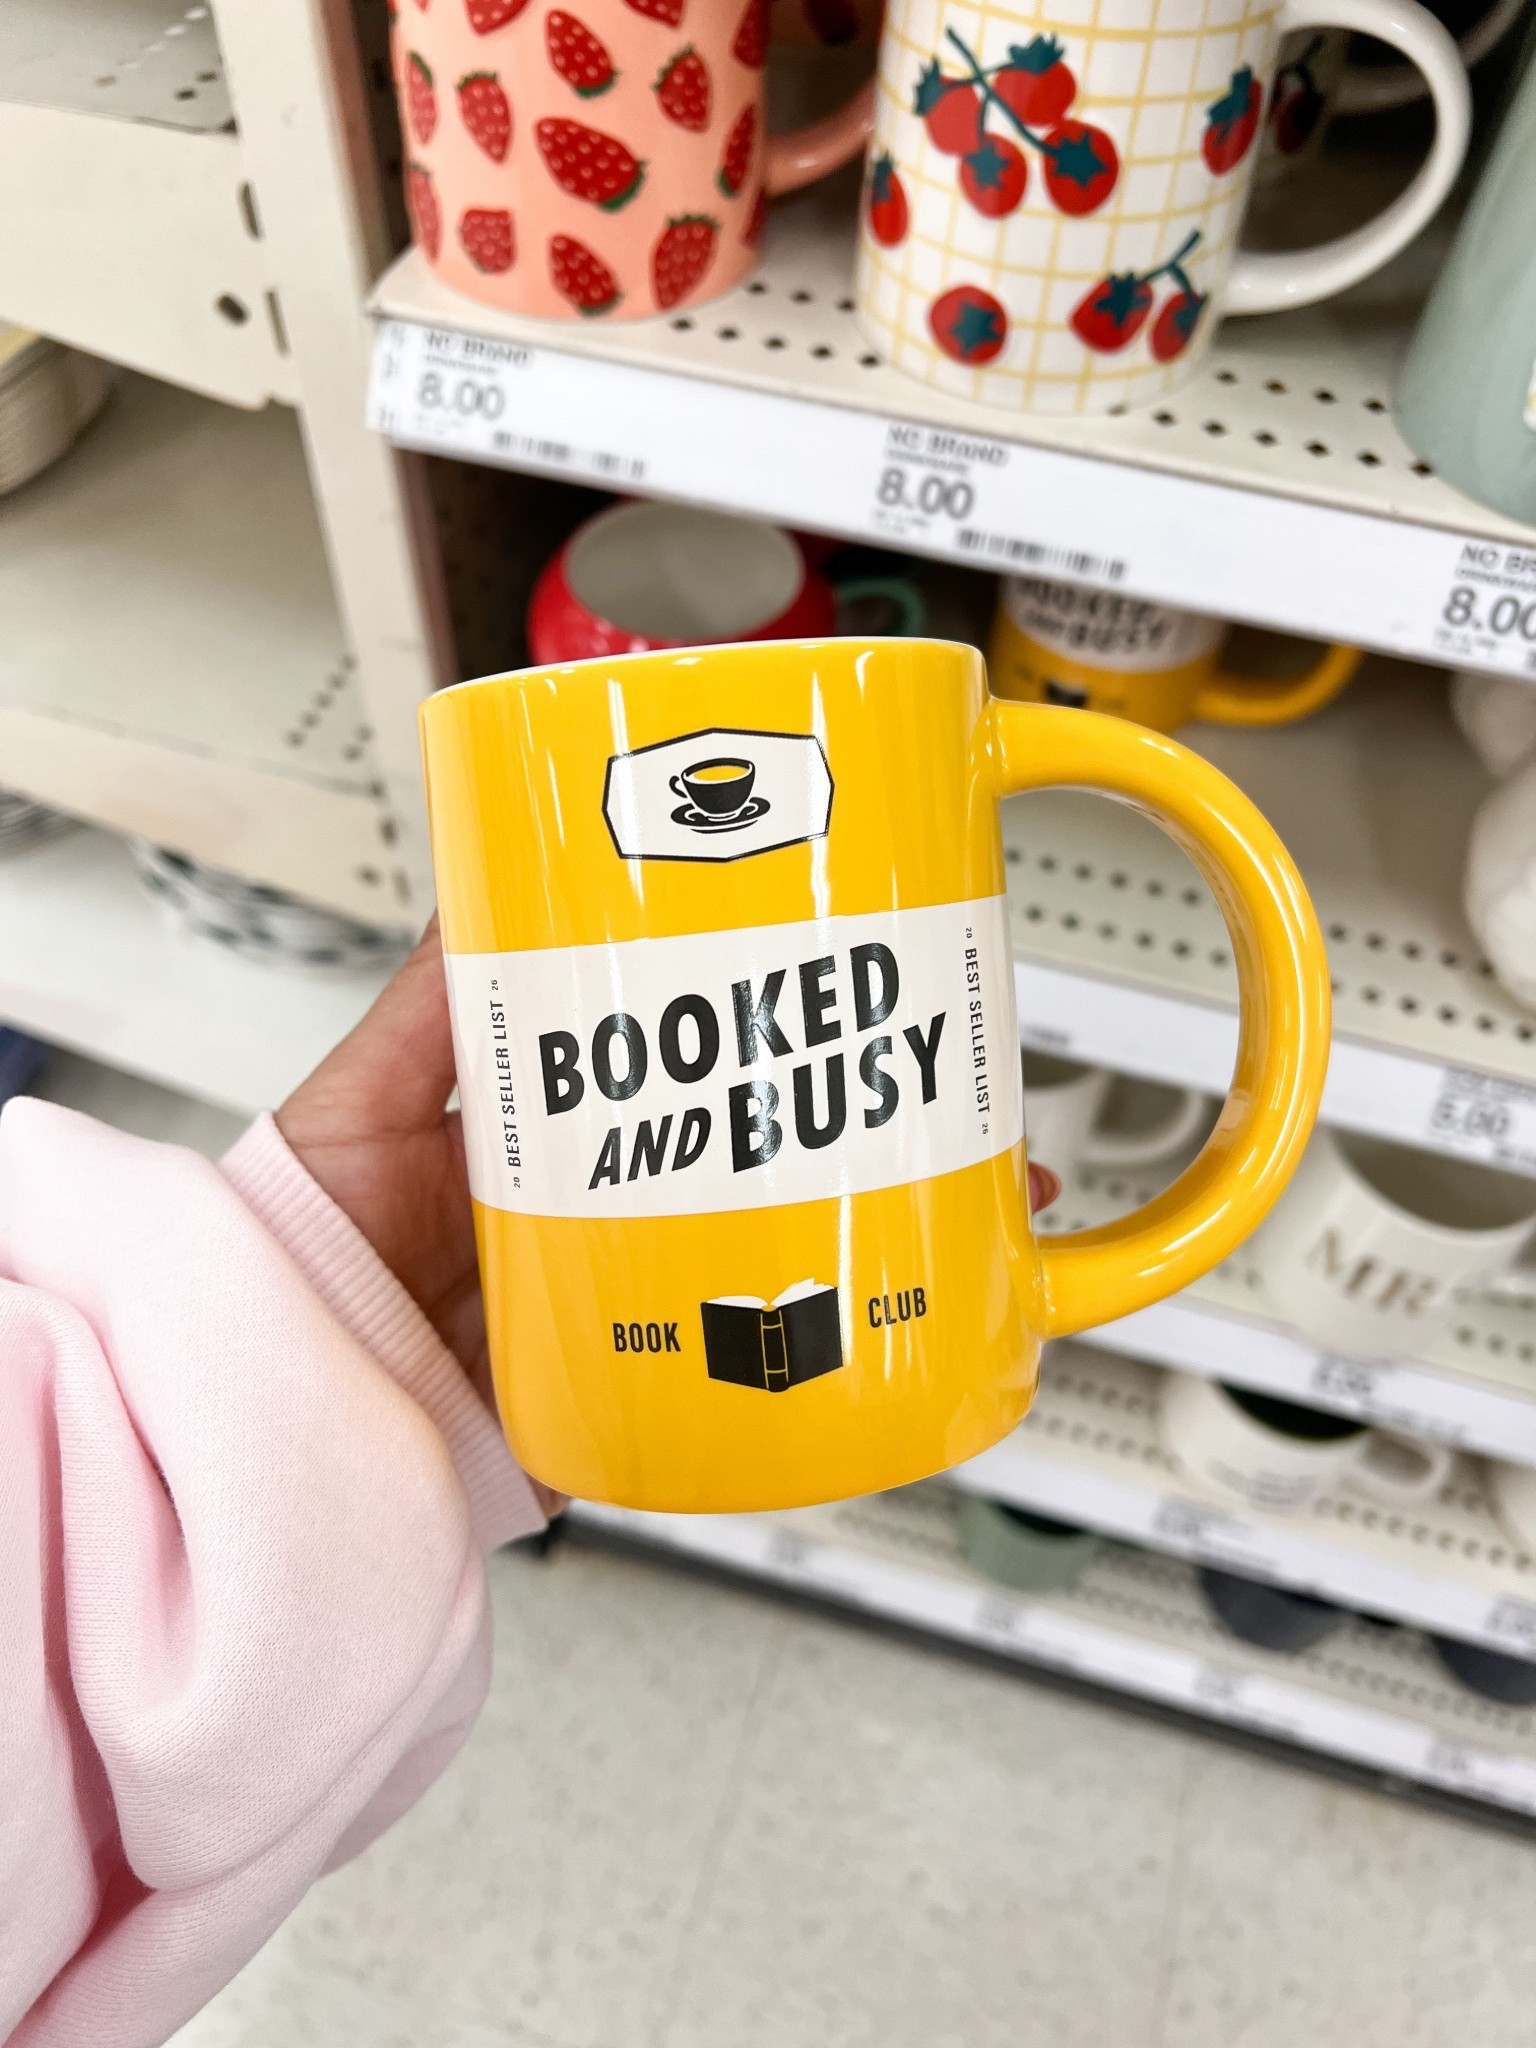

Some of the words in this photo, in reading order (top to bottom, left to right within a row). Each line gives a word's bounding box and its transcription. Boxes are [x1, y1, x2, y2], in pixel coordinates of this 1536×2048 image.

[418, 371, 506, 421] 8.00
[878, 466, 974, 520] 8.00
[1461, 544, 1499, 570] NO
[965, 948, 981, 993] BEST
[490, 1000, 507, 1040] LIST
[538, 942, 900, 1116] BOOKED
[969, 1000, 987, 1069] SELLER
[495, 1047, 515, 1115] SELLER
[588, 1107, 712, 1190] AND
[728, 1012, 947, 1173] BUSY
[975, 1074, 990, 1113] LIST
[504, 1121, 522, 1168] BEST
[612, 1322, 682, 1353] BOOK
[868, 1287, 927, 1329] CLUB
